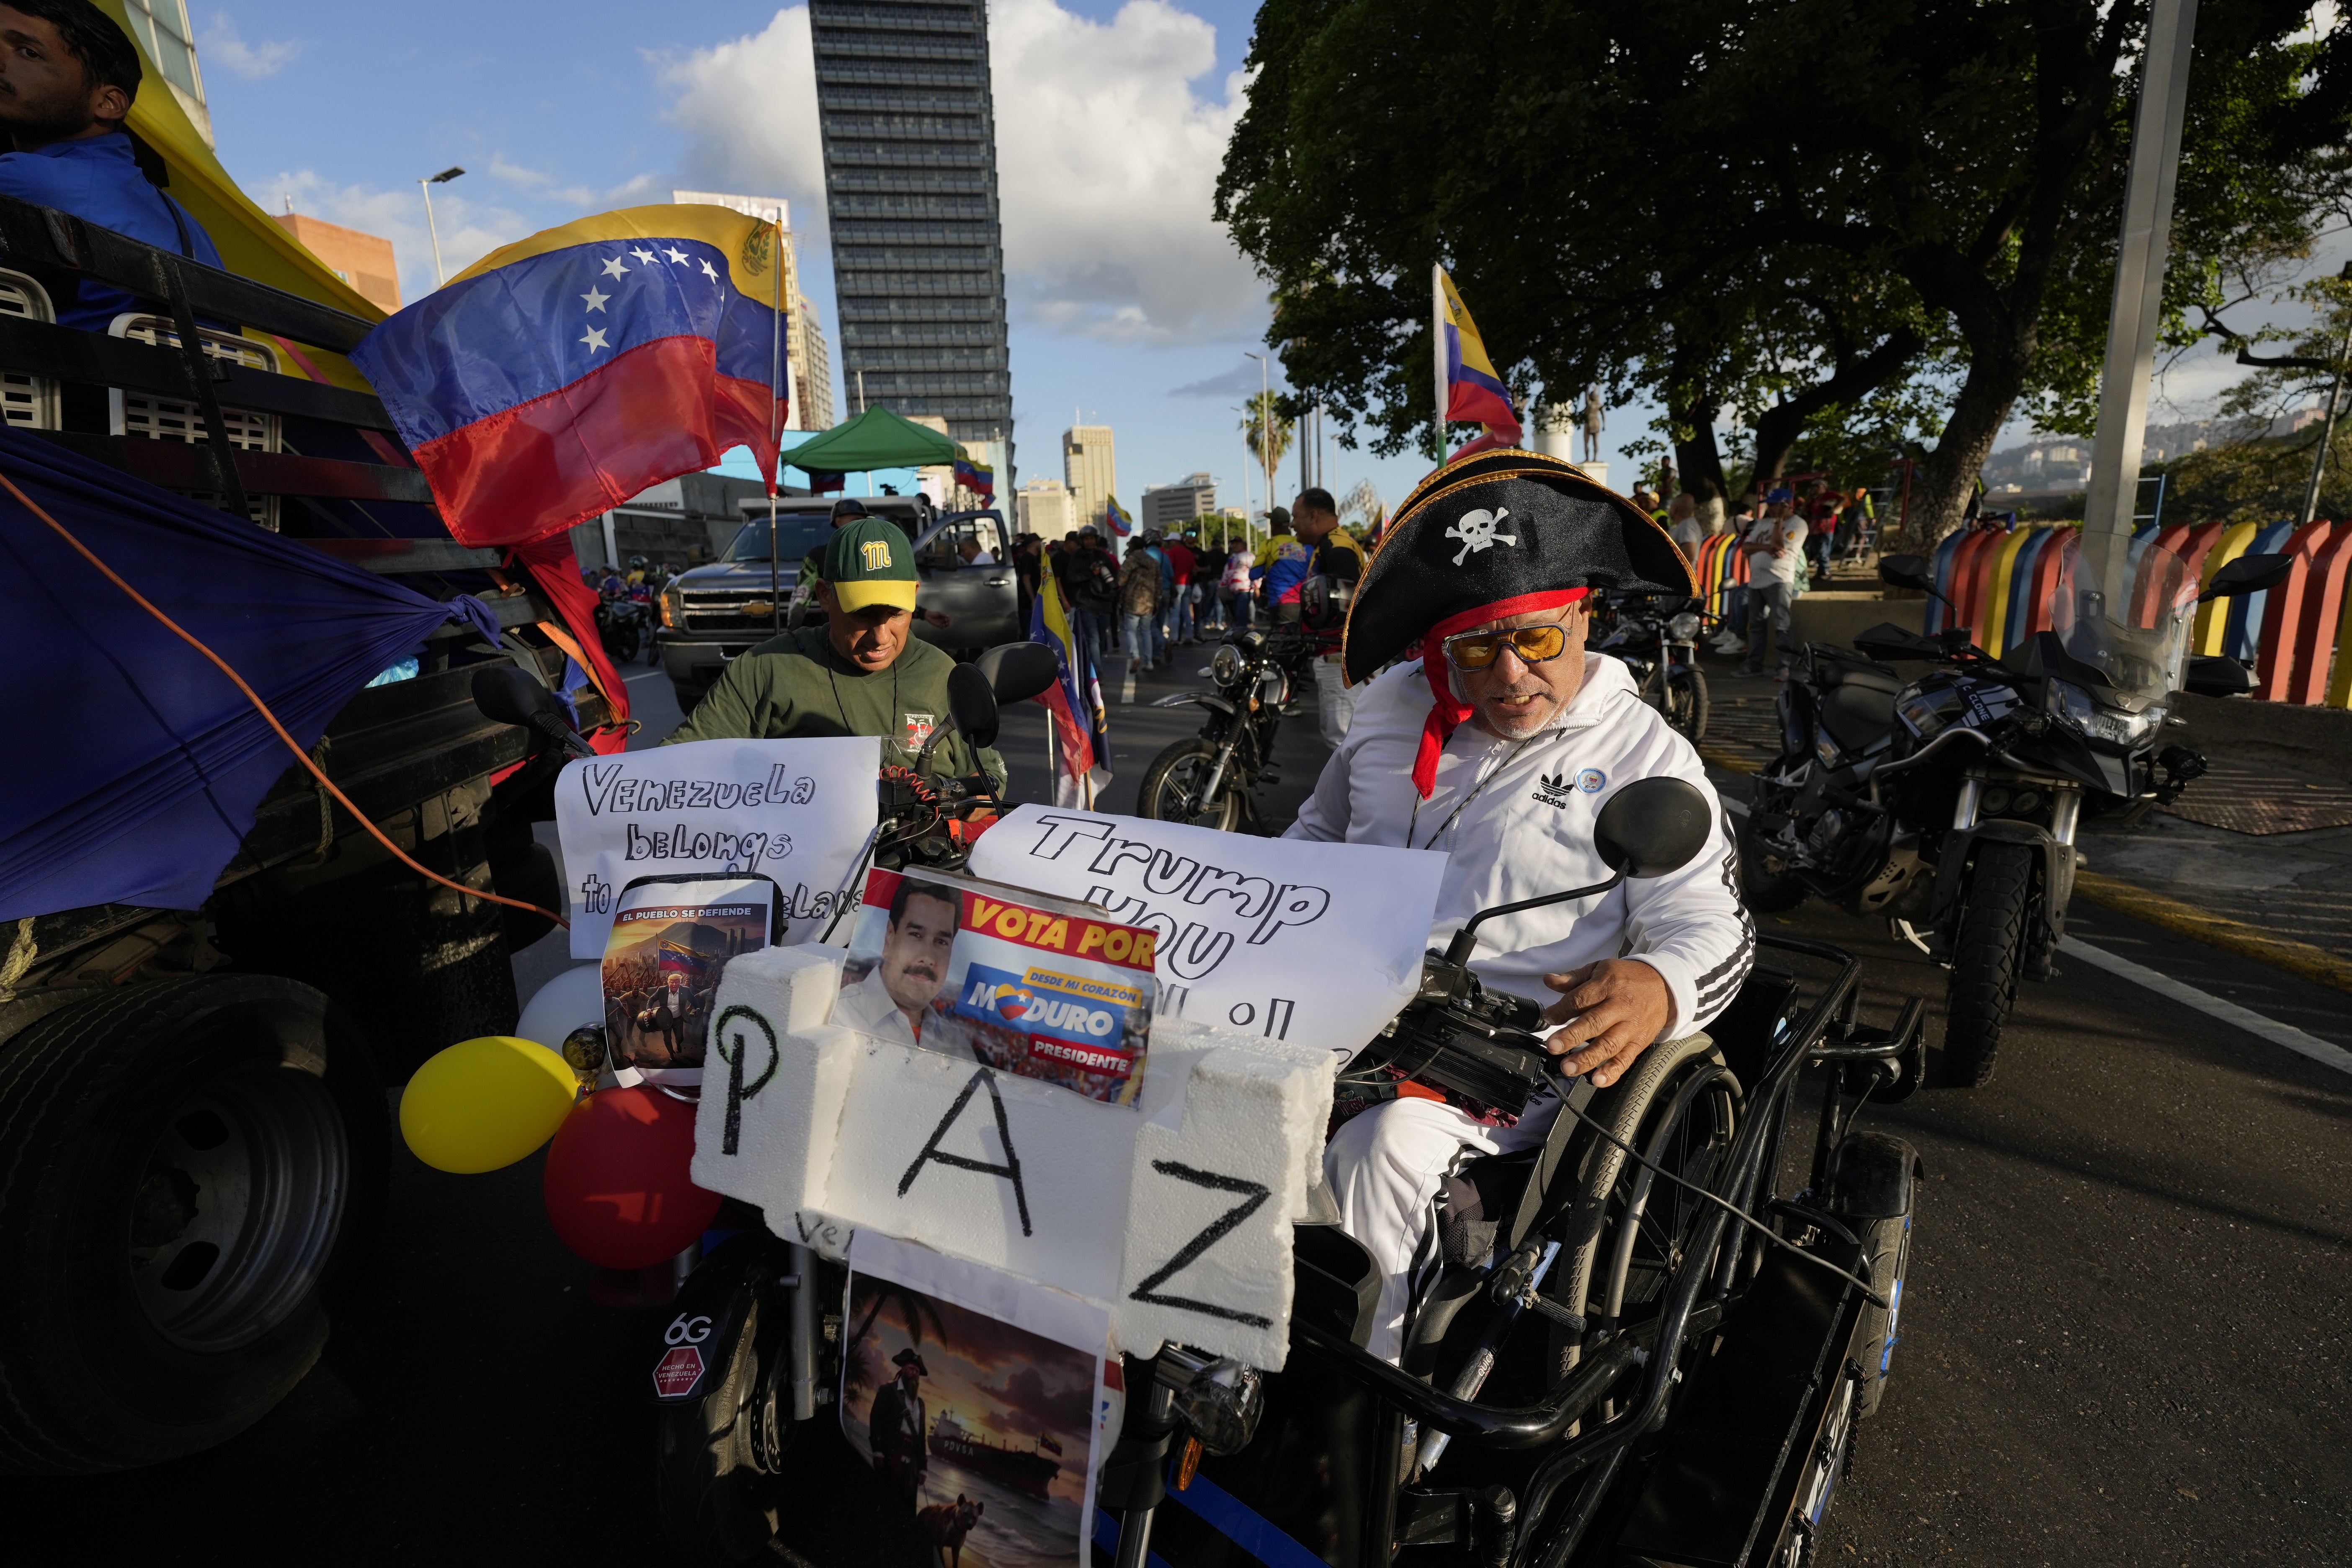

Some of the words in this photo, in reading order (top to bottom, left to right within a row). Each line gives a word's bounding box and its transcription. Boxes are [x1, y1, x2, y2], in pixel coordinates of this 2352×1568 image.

[1532, 792, 1567, 810] adidas
[581, 873, 612, 914] to
[1029, 815, 1330, 945] Trump
[622, 913, 633, 922] EL
[636, 910, 678, 920] PUEBLO
[681, 909, 695, 918] SE
[698, 907, 751, 917] DEFIENDE
[971, 898, 1068, 950] VOTA
[1076, 923, 1155, 967] POR
[1029, 972, 1064, 986] DESDE
[1065, 980, 1080, 990] MI
[1081, 981, 1137, 1002] CORAZÓN
[967, 980, 1114, 1037] MDURO
[1034, 1040, 1127, 1072] PRESIDENTE
[665, 1313, 712, 1345] 6G
